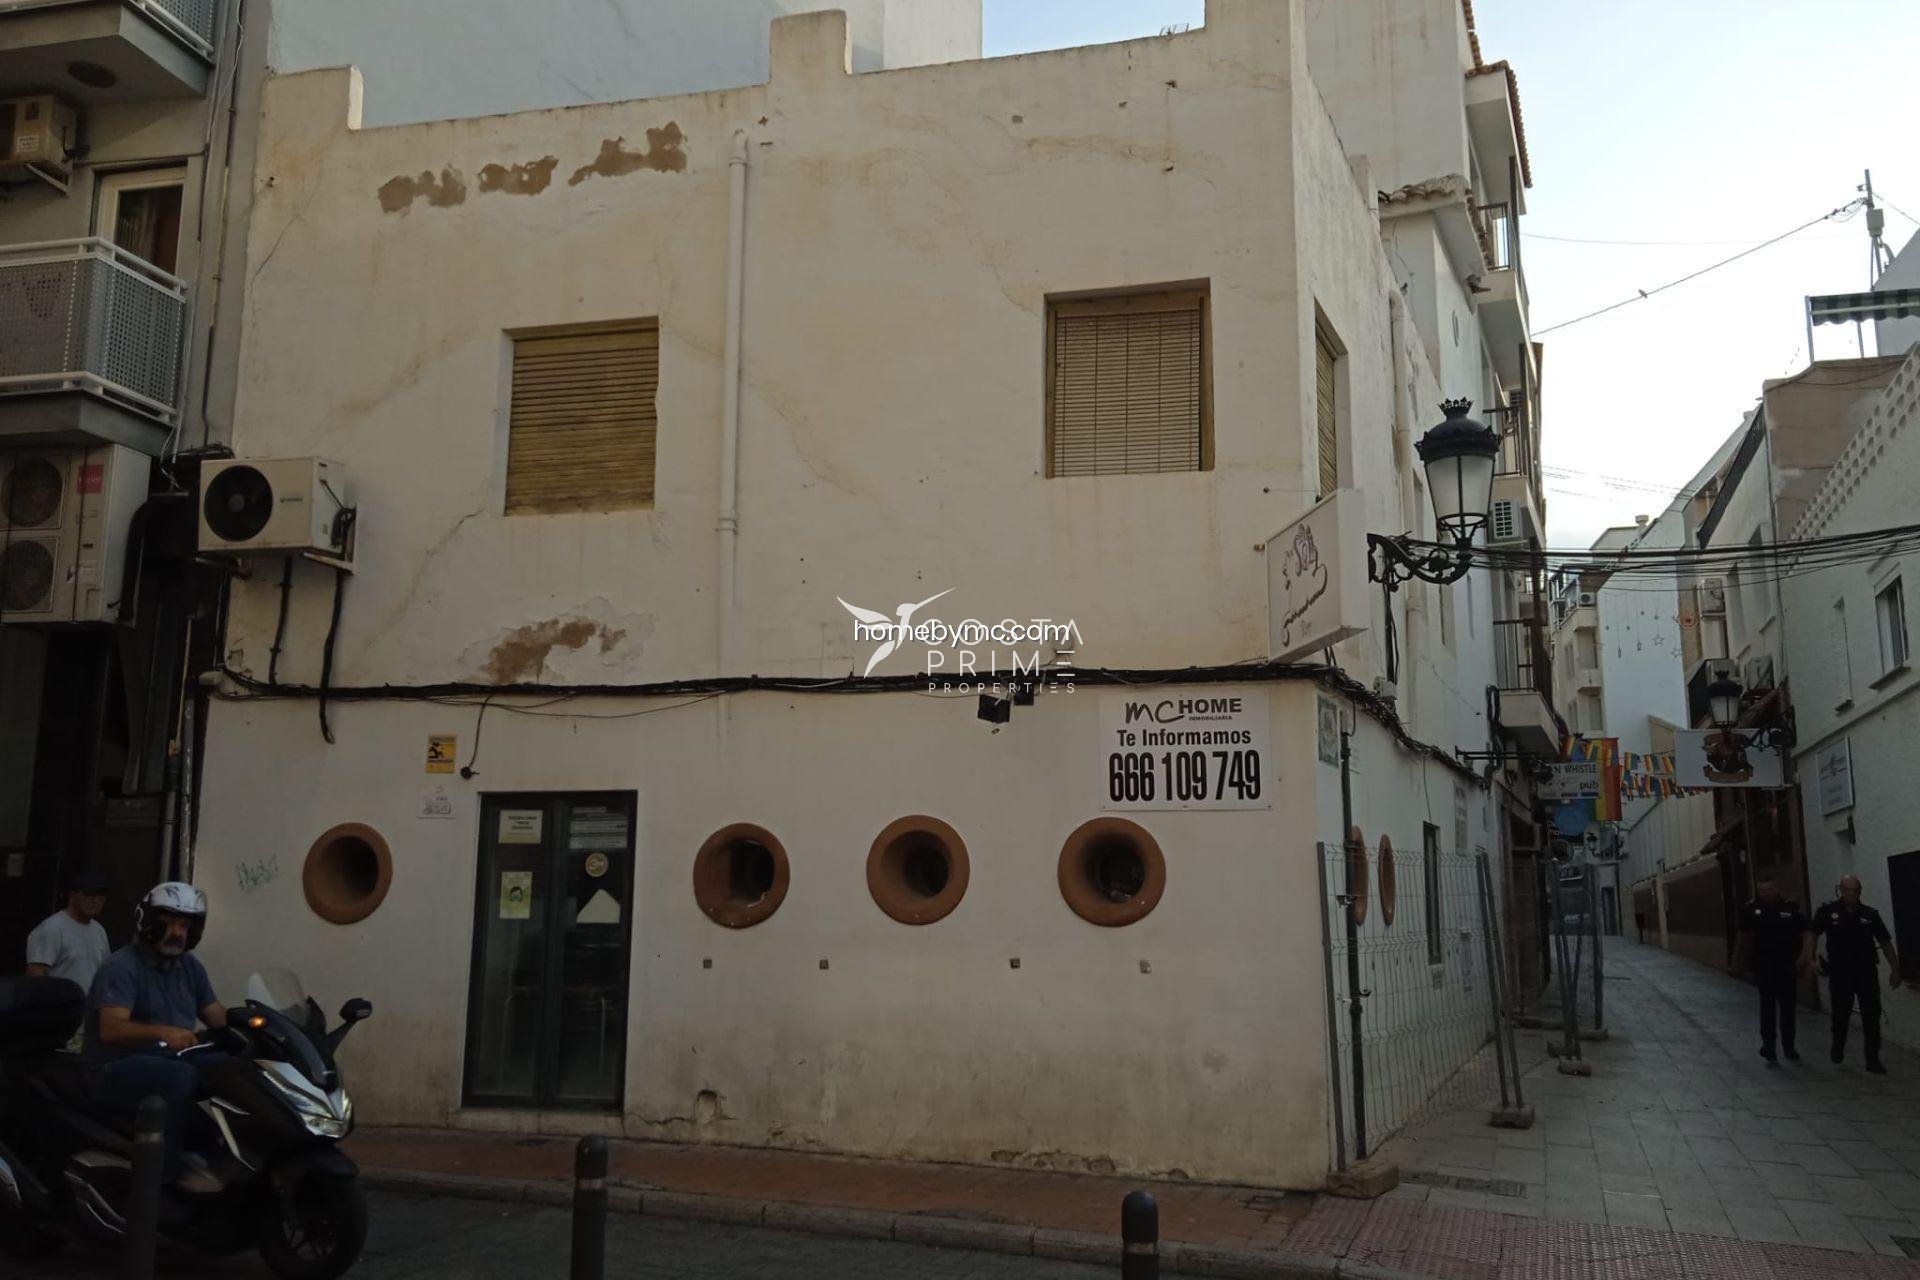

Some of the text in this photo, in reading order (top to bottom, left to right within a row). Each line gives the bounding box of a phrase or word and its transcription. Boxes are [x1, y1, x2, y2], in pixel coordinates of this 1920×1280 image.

[1117, 729, 1251, 746] Te Informamos
[1109, 749, 1261, 802] 666 109 749
[1564, 763, 1597, 774] WHISTLE
[1579, 779, 1599, 790] pub
